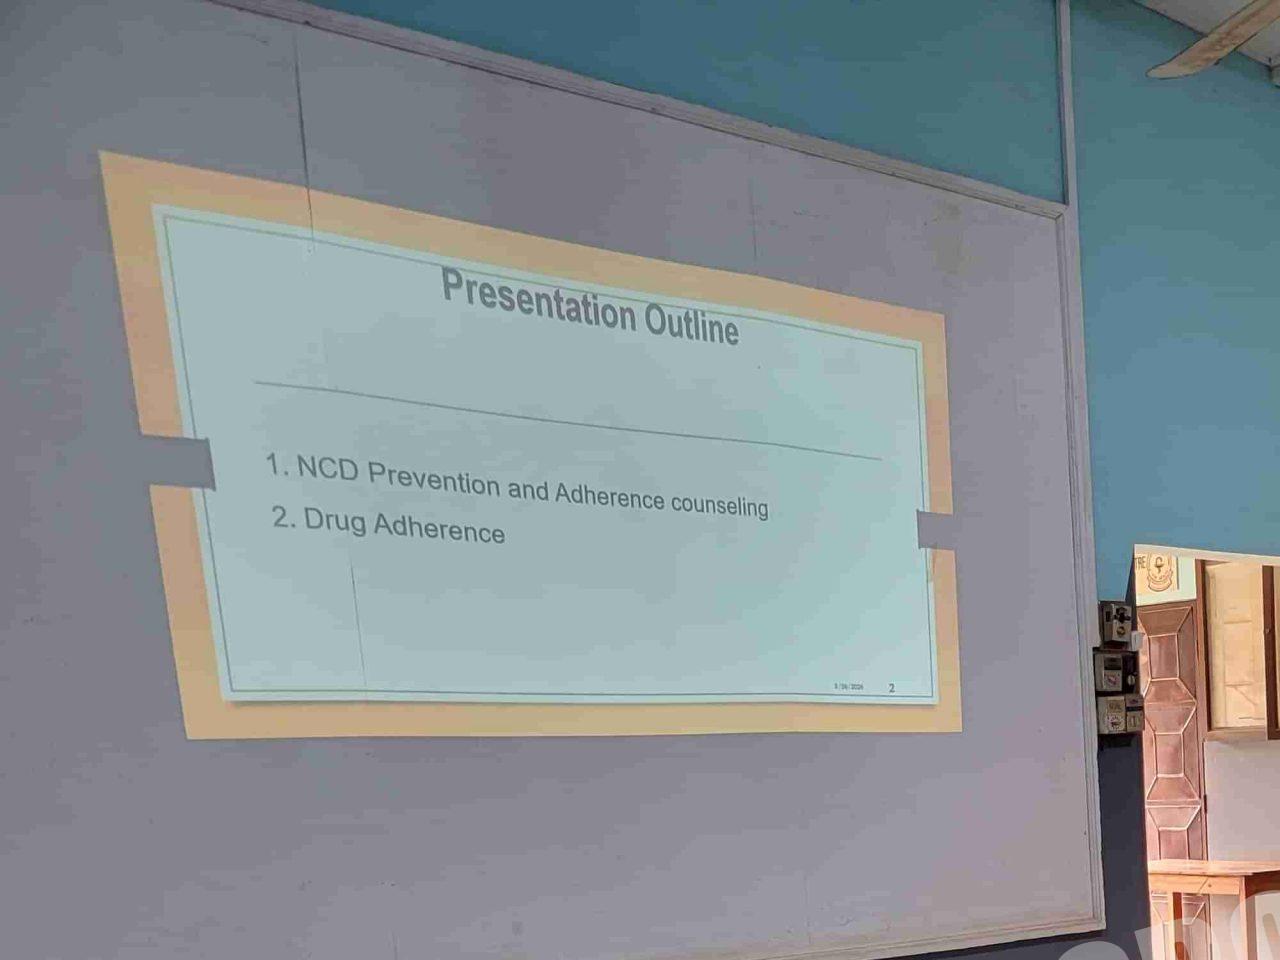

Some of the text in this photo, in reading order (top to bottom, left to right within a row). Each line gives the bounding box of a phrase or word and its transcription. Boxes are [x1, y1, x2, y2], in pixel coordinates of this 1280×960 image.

[442, 267, 739, 345] Presentation Outline
[266, 454, 768, 521] 1. NCD Prevention and Adherence counseling
[272, 505, 505, 544] 2. Drug Adherence
[888, 683, 896, 693] 2
